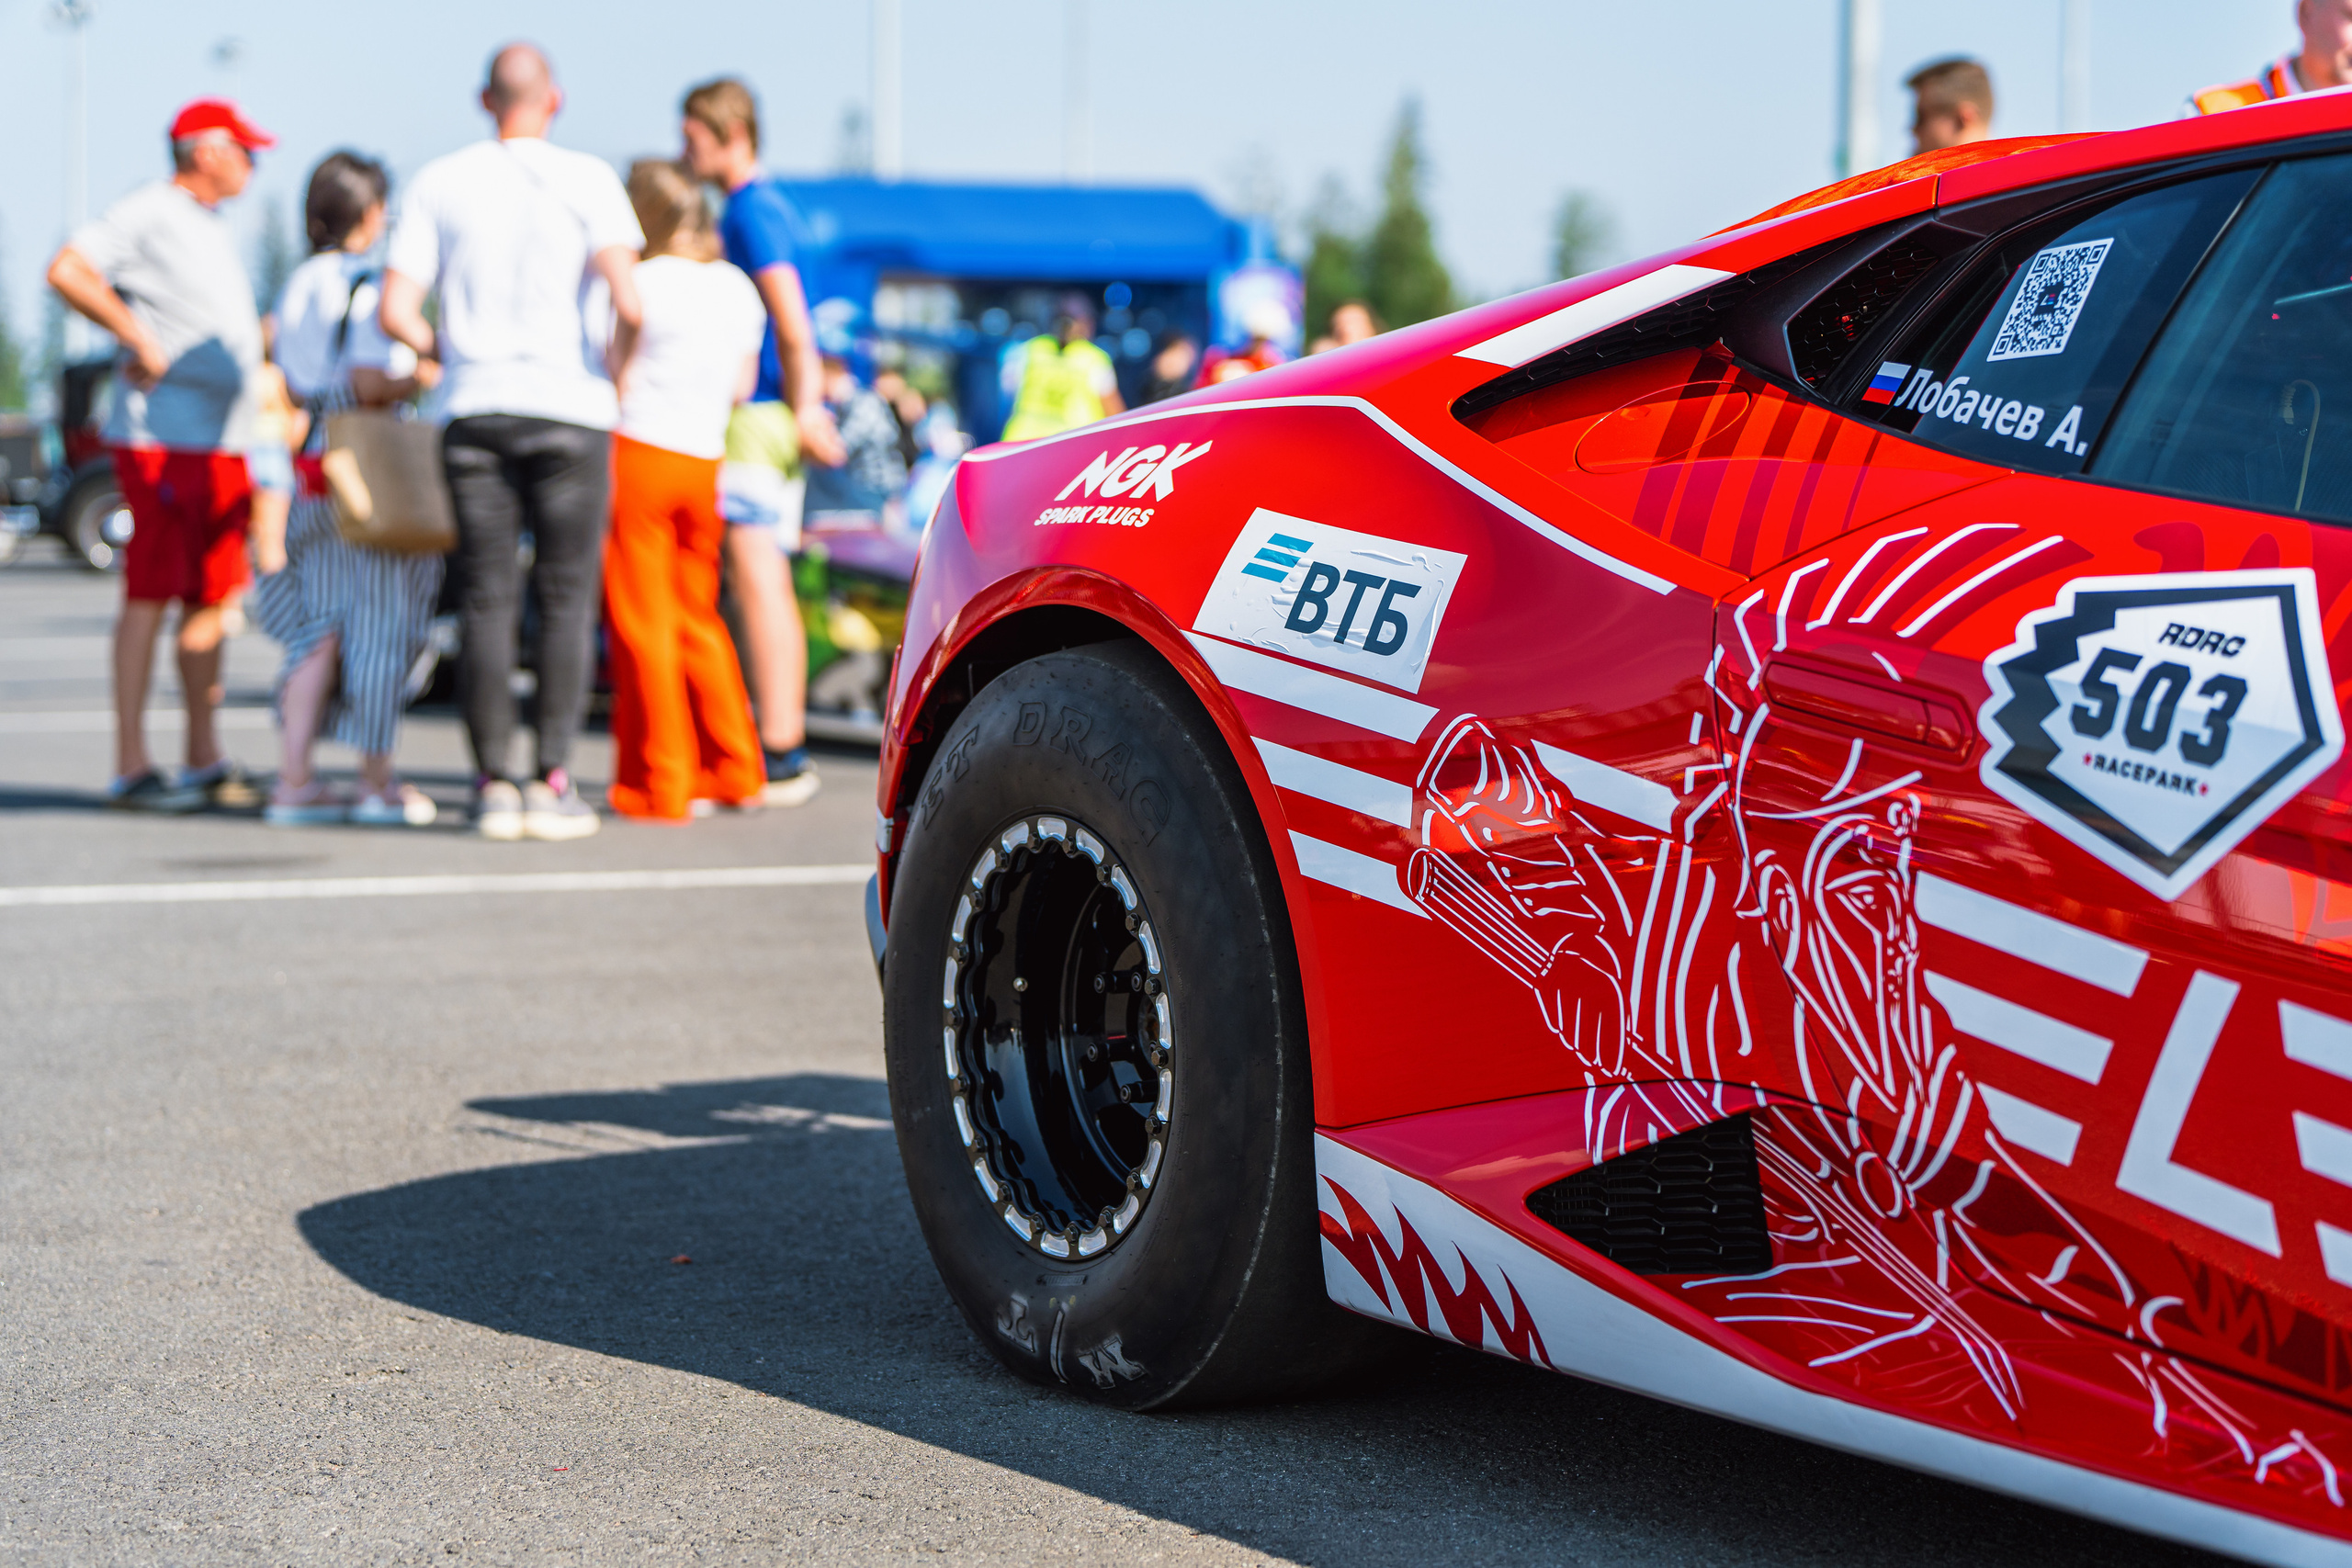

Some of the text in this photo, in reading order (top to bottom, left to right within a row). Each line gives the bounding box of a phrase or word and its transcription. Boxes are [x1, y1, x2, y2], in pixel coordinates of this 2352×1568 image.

[1894, 368, 2088, 457] Лобачев А.
[1054, 440, 1214, 502] NGK
[1034, 506, 1155, 528] SPARK PLUGS
[1284, 561, 1422, 657] ВТБ
[2158, 622, 2246, 659] RDRC
[2069, 647, 2248, 770] 503
[1012, 700, 1170, 848] DRAG
[2093, 753, 2198, 797] RACEPARK
